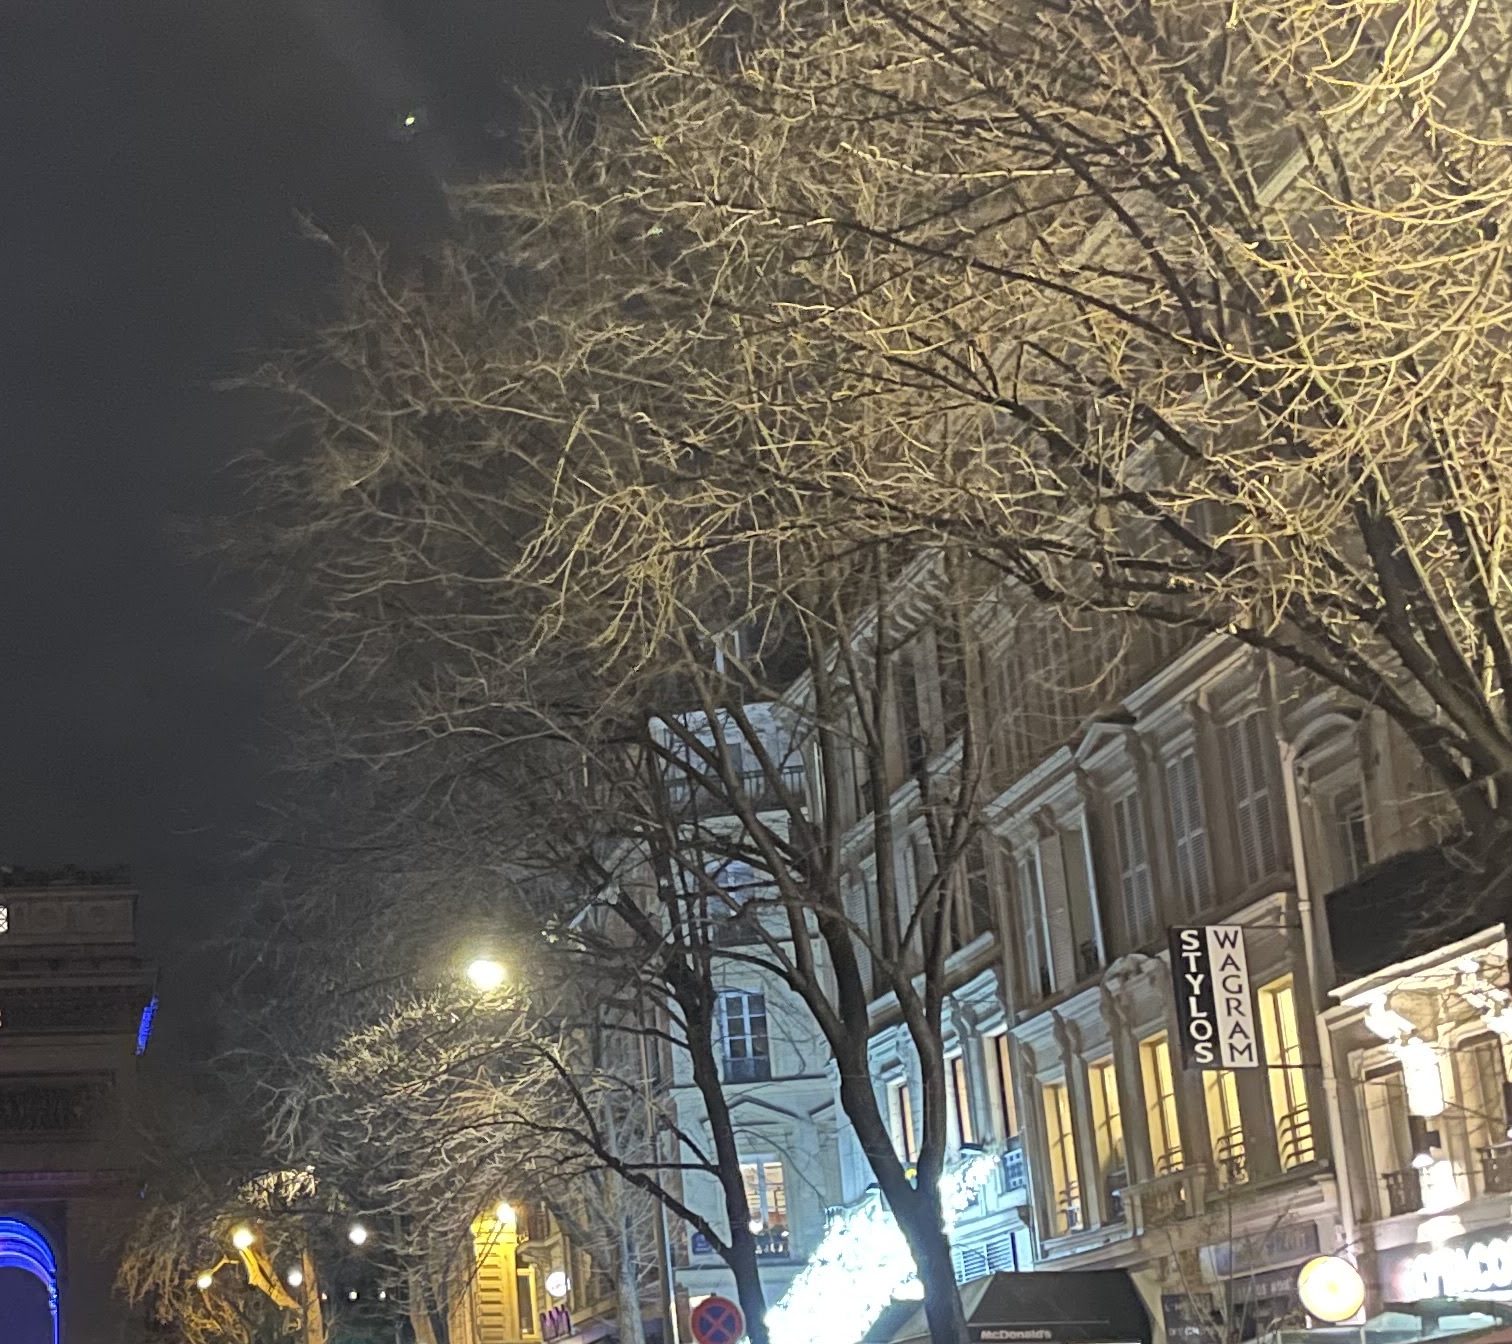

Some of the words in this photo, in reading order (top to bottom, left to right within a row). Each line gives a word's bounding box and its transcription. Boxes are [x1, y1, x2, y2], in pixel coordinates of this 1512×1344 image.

[1180, 930, 1214, 1063] STYLOS
[1213, 930, 1254, 1062] WAGRAM
[980, 1330, 1052, 1340] McDonald's
